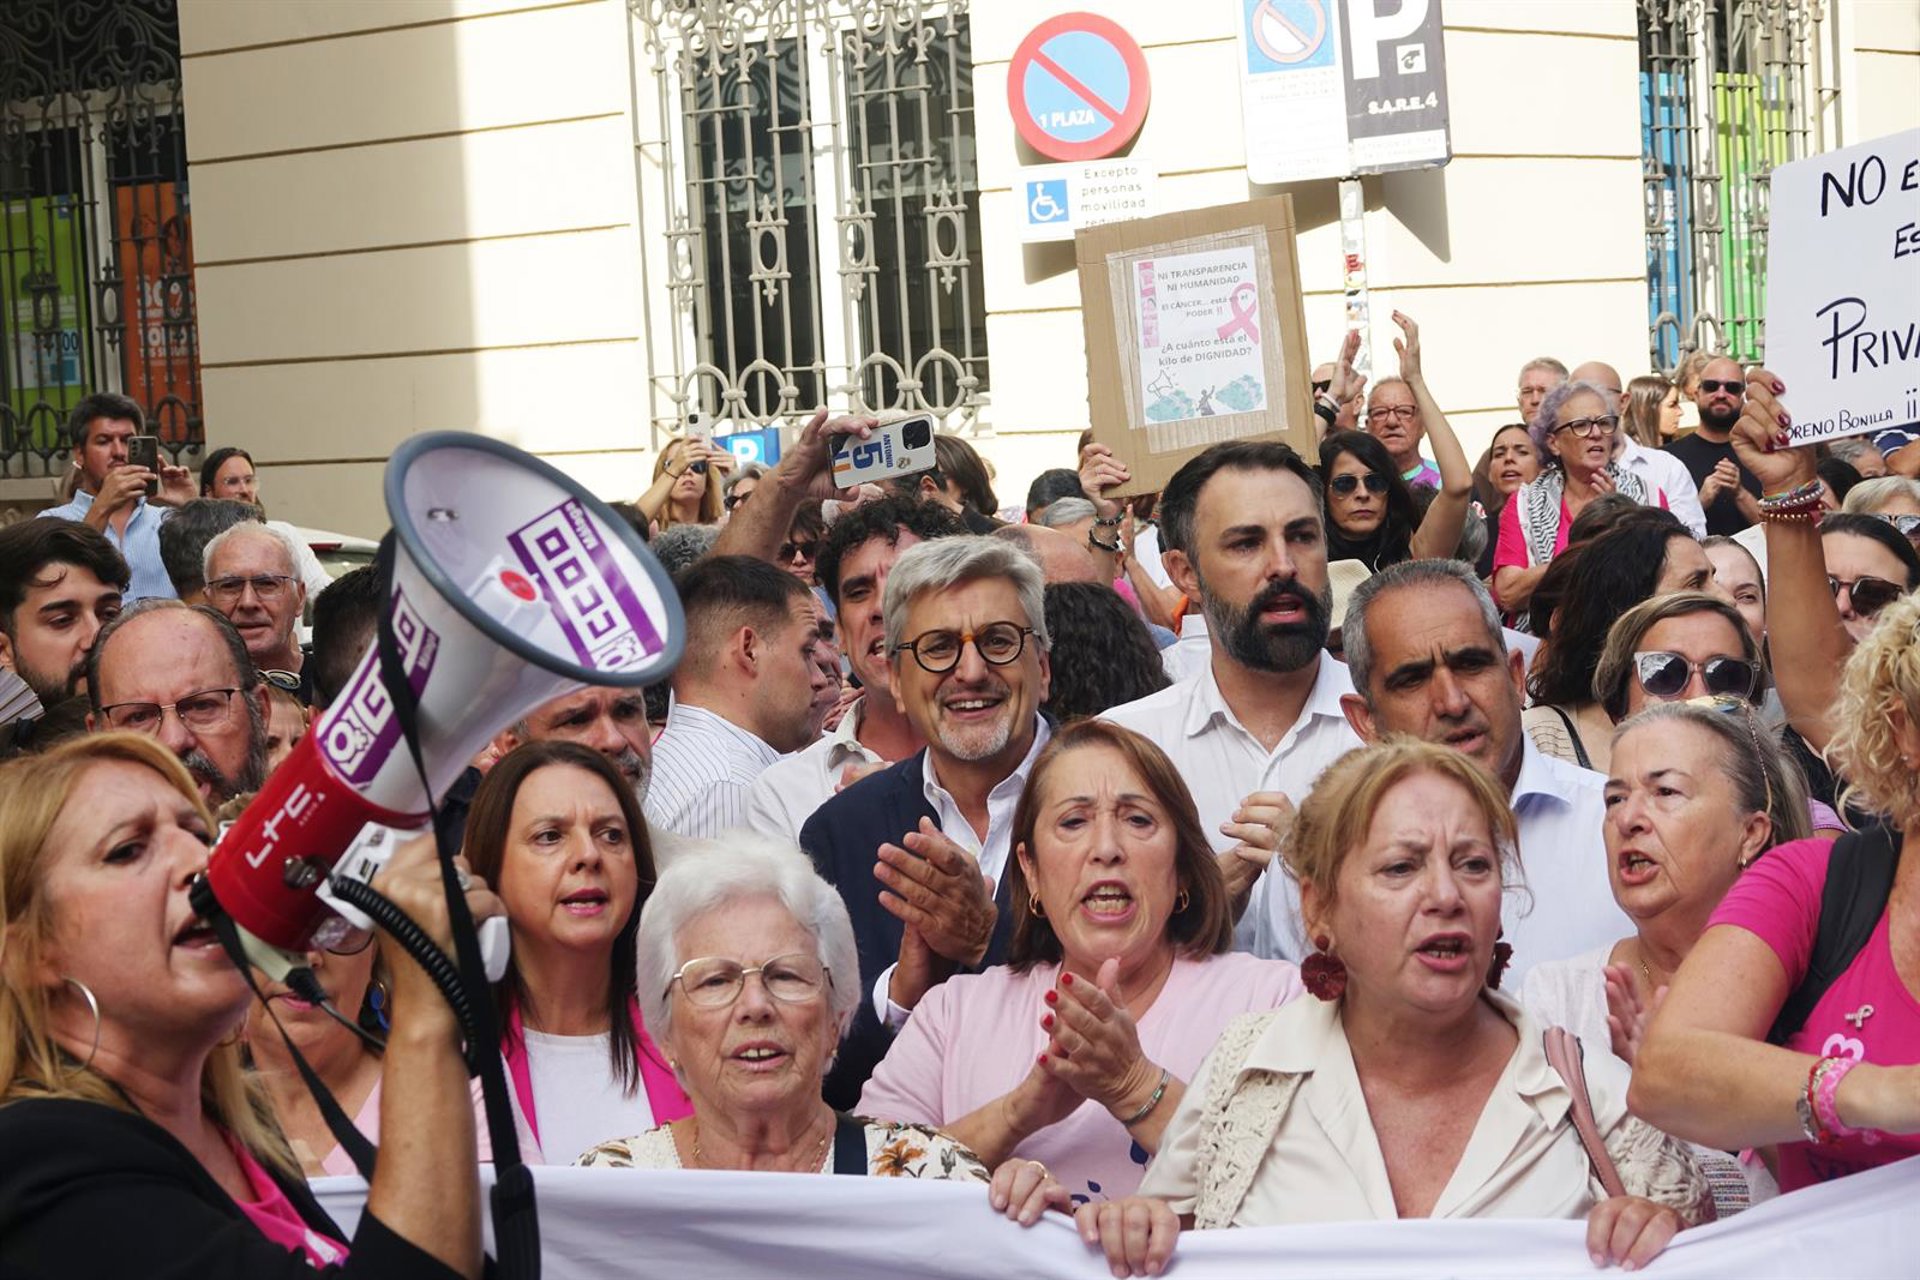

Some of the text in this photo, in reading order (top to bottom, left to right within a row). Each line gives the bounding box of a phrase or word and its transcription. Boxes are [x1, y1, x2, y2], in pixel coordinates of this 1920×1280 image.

[1347, 0, 1429, 80] P
[1368, 91, 1438, 115] S.A.R.E. 4
[1039, 108, 1095, 129] 1 PLAZA
[1084, 167, 1138, 179] Excepto
[1081, 183, 1142, 197] personas
[1821, 155, 1886, 217] NO
[1080, 198, 1146, 212] movilidad
[1171, 262, 1248, 279] TRANSPARENCIA
[1167, 275, 1240, 292] NI HUMANIDAD
[1186, 308, 1213, 318] PODER
[1161, 343, 1174, 354] ¿A
[1176, 338, 1211, 350] cuánto
[1238, 333, 1247, 342] el
[1816, 297, 1920, 379] PRIV
[1158, 347, 1252, 366] kilo de DIGNIDAD?
[1785, 419, 1834, 440] ORENO
[1839, 409, 1893, 432] BONILLA
[732, 438, 760, 467] P
[852, 441, 884, 469] 5
[882, 433, 894, 468] ANTONIO
